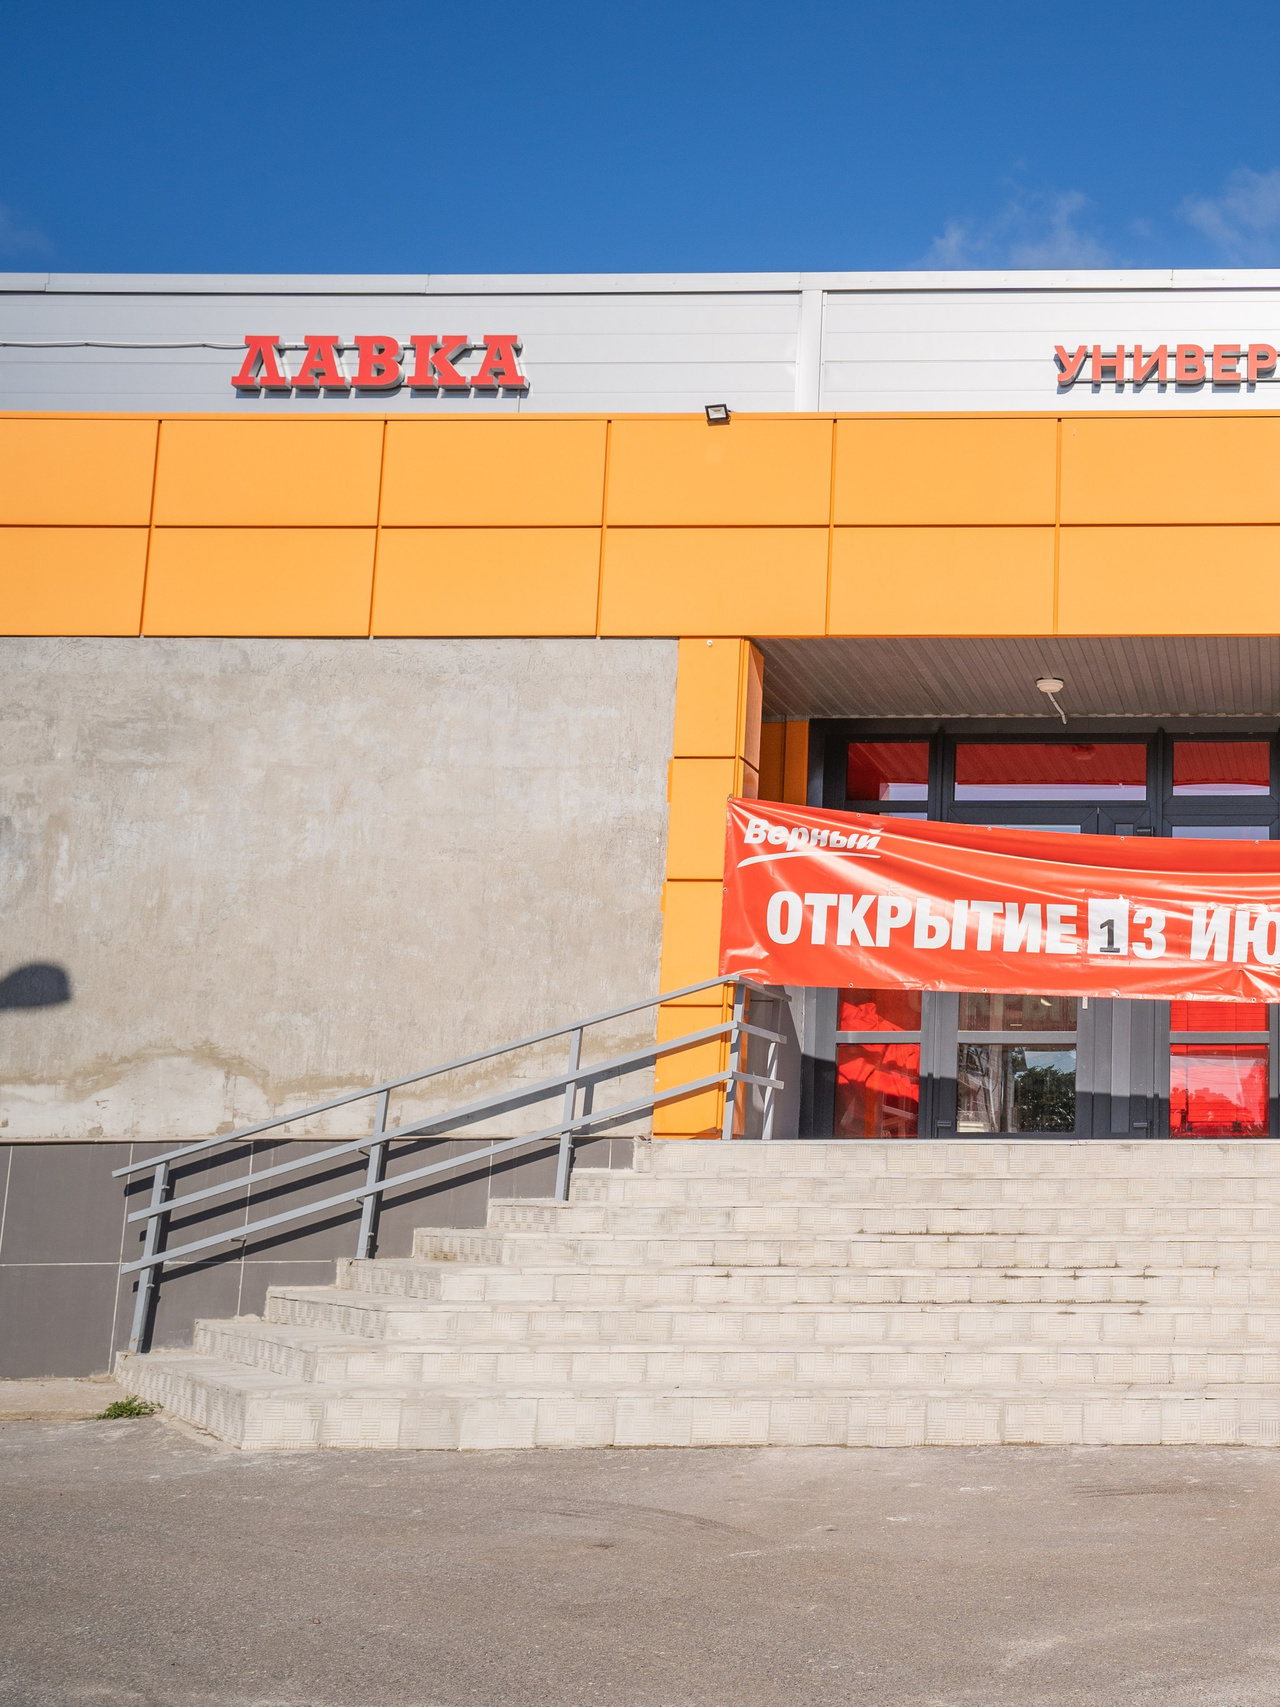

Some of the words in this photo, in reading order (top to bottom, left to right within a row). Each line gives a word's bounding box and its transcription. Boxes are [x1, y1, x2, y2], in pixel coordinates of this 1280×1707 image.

[231, 335, 528, 390] ЛАВКА
[744, 818, 884, 852] Верный
[766, 890, 1078, 956] ОТКРЫТИЕ
[1099, 908, 1167, 960] 13
